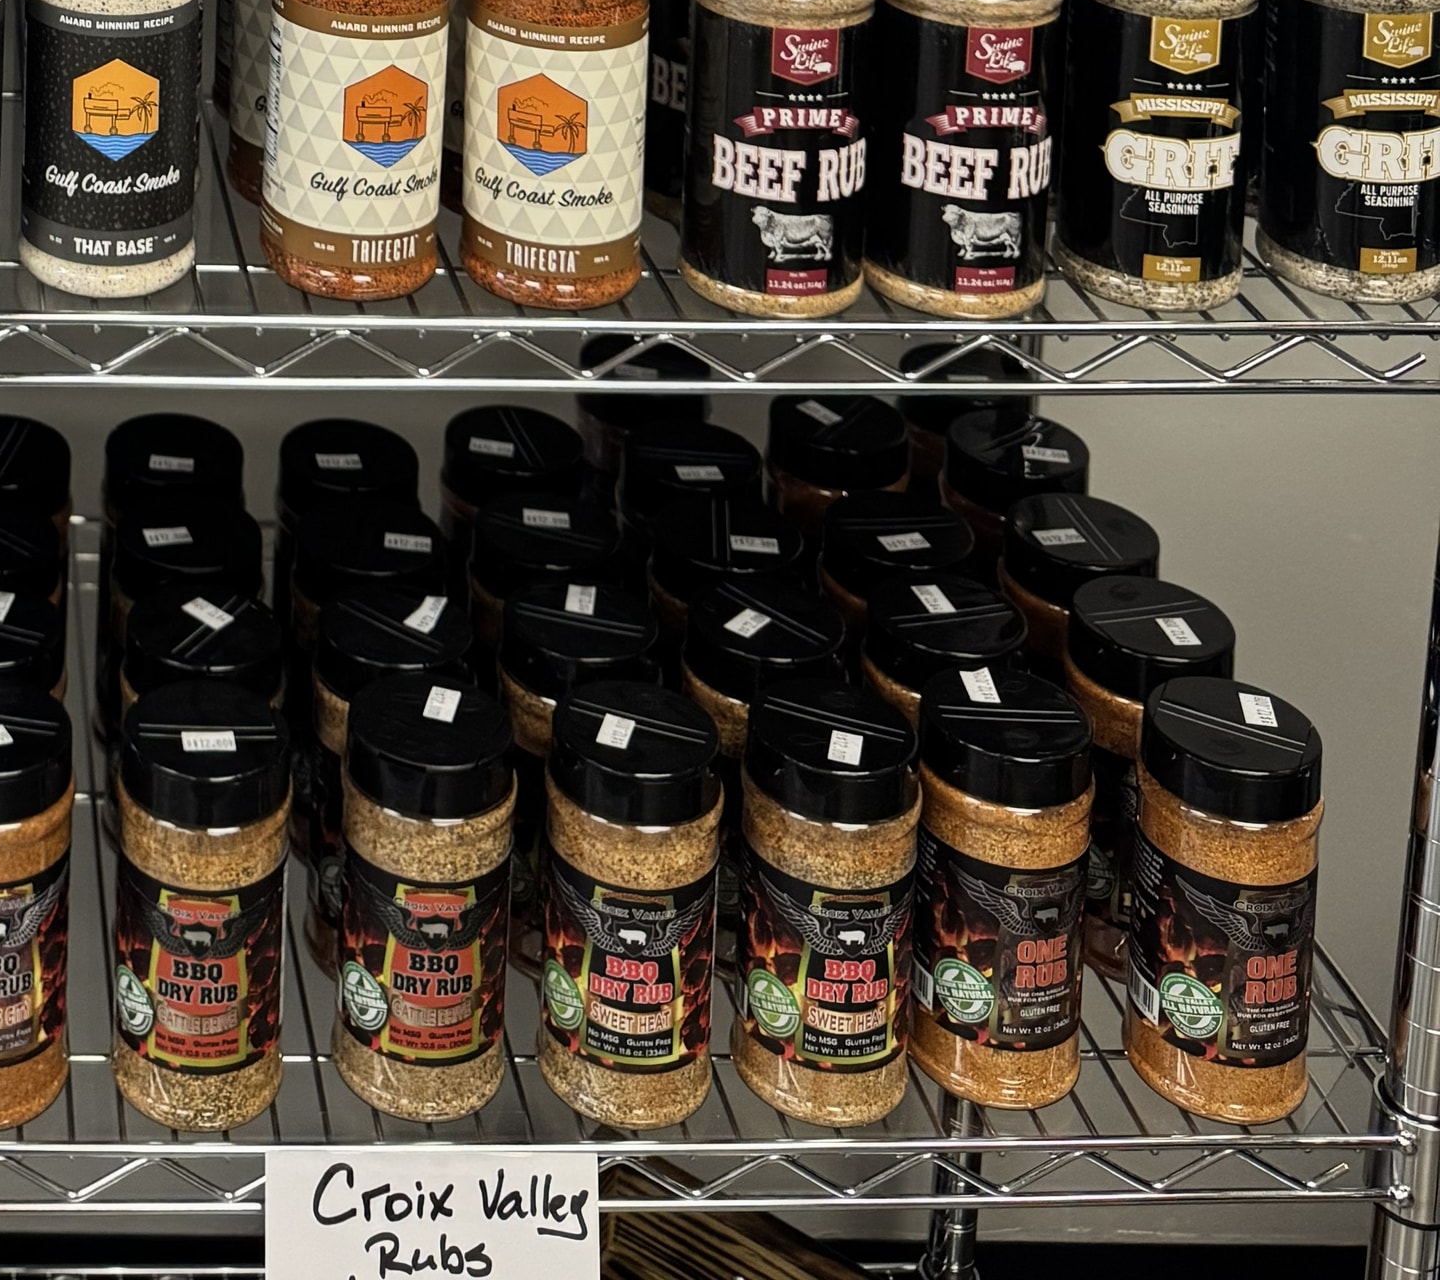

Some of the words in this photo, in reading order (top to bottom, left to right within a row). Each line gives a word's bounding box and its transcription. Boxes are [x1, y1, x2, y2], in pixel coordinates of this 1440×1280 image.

[761, 108, 843, 128] PRIME
[1136, 98, 1225, 116] MISSISSIPPI
[712, 133, 807, 202] BEEF
[816, 137, 866, 202] RUB
[1144, 190, 1162, 203] ALL
[1164, 192, 1204, 205] PURPOSE
[1148, 201, 1200, 215] SEASONING
[505, 239, 576, 273] TRIFECTA
[606, 955, 658, 985] BBQ
[1247, 950, 1298, 979] ONE
[590, 972, 630, 1002] DRY
[633, 983, 673, 1004] RUB
[1245, 975, 1297, 1004] RUB
[590, 1002, 634, 1032] SWEET
[638, 1010, 672, 1033] HEAT
[1250, 1023, 1276, 1033] GLUTEN
[1276, 1020, 1290, 1030] FREE
[313, 1163, 454, 1226] Croix
[479, 1168, 589, 1240] Valley
[364, 1232, 493, 1279] Rubs
